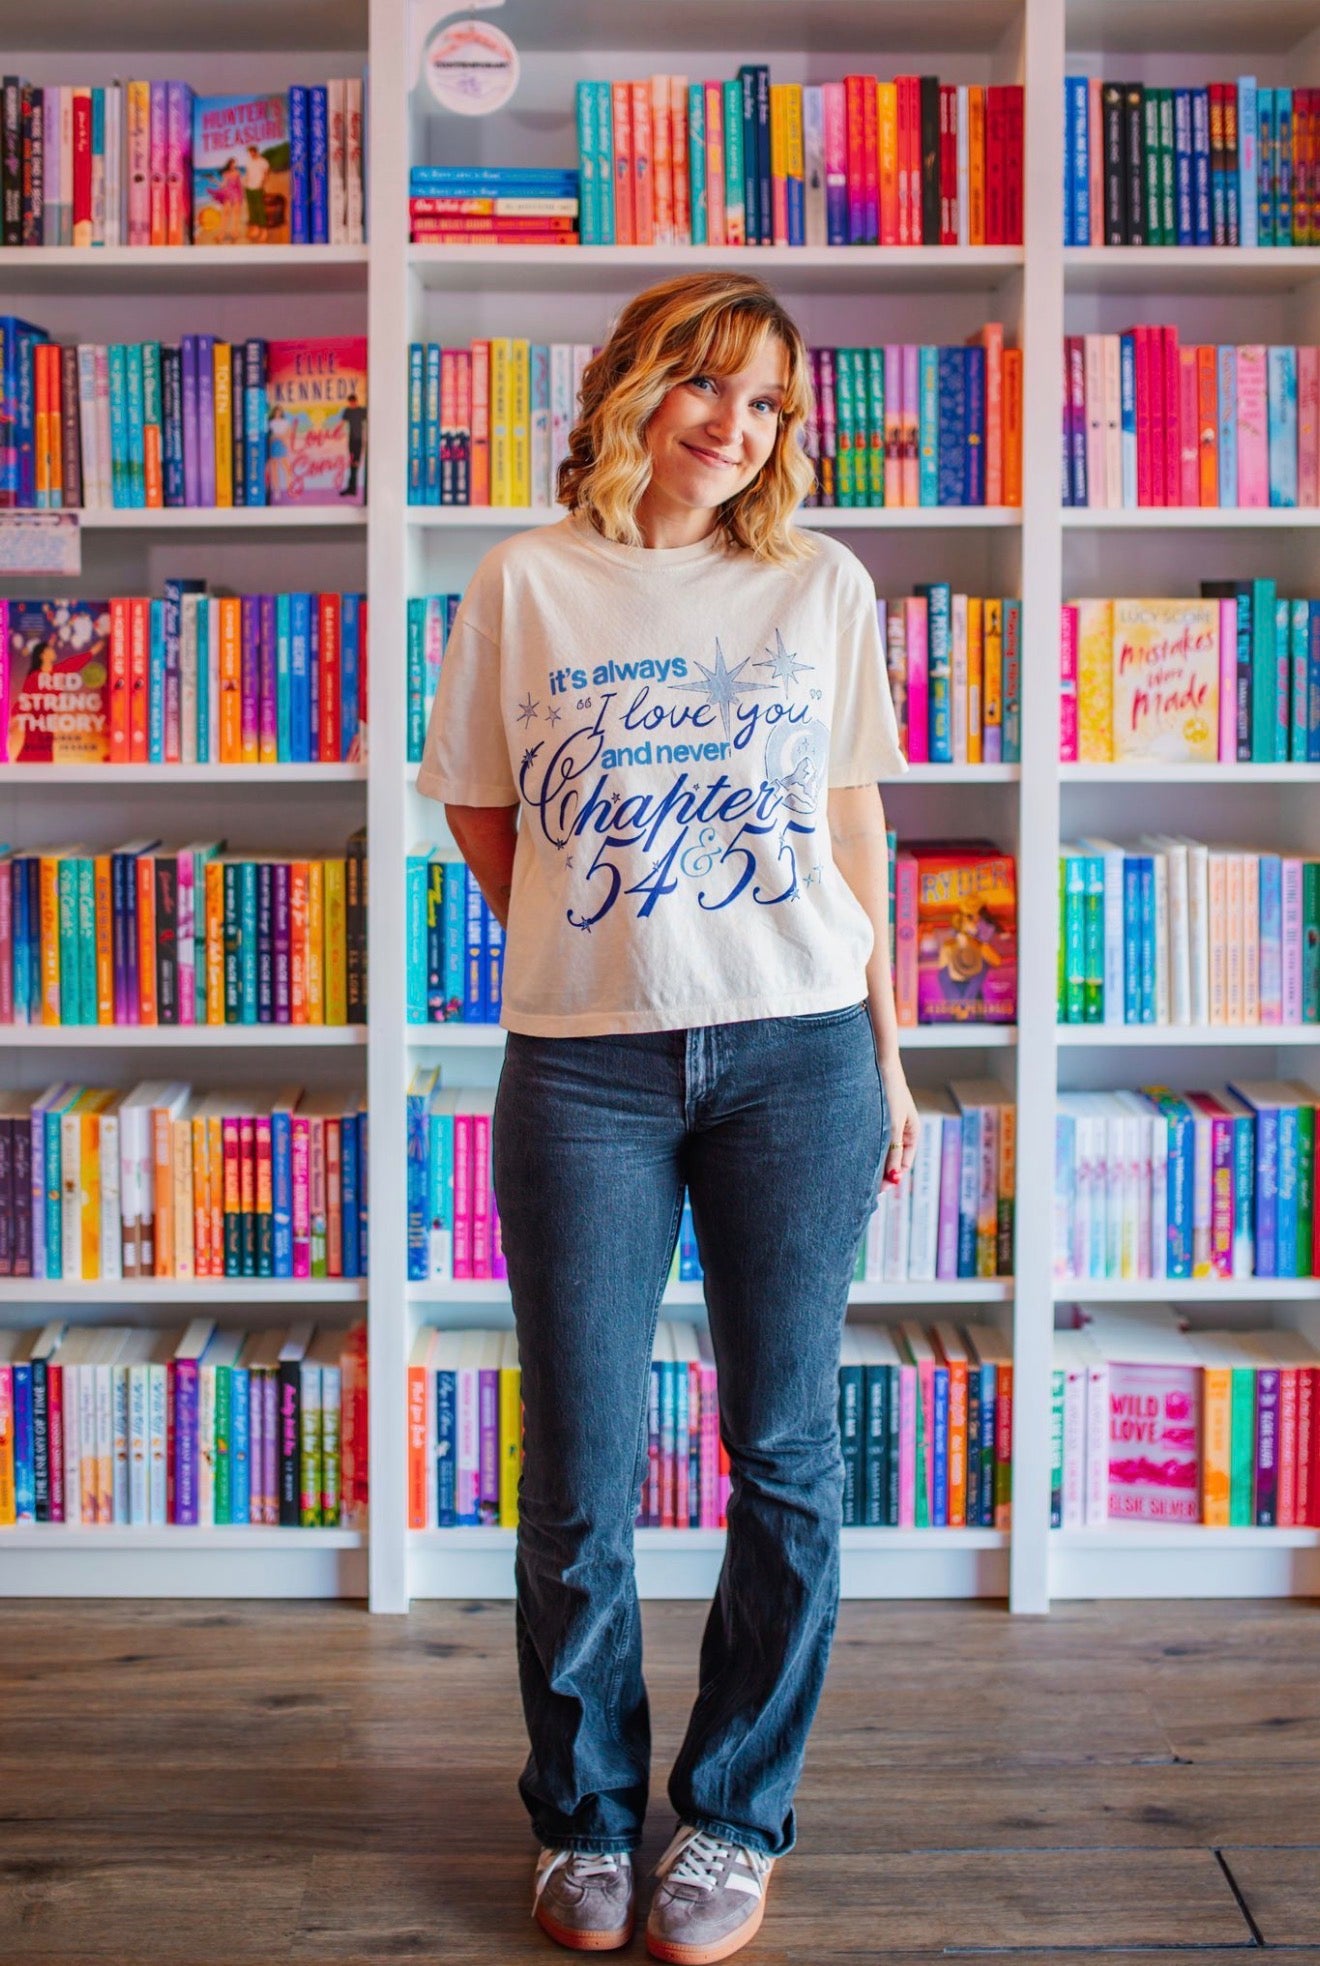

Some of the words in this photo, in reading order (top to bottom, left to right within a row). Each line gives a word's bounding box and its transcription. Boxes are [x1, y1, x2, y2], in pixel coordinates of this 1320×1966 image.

[296, 352, 335, 375] ELLE
[217, 365, 229, 415] TOKEN
[275, 378, 358, 402] KENNEDY
[37, 672, 82, 691] RED
[549, 668, 588, 696] it's
[592, 656, 688, 686] always
[19, 692, 102, 712] STRING
[619, 686, 716, 730] love
[16, 713, 106, 732] THEORY
[600, 742, 652, 770] and
[656, 741, 731, 765] never
[519, 727, 784, 851] Chapter
[680, 828, 723, 877] &
[698, 819, 815, 910] 55
[567, 826, 688, 930] 54
[920, 861, 1009, 904] RYDER
[1110, 1392, 1158, 1418] WILD
[1110, 1419, 1155, 1444] LOVE
